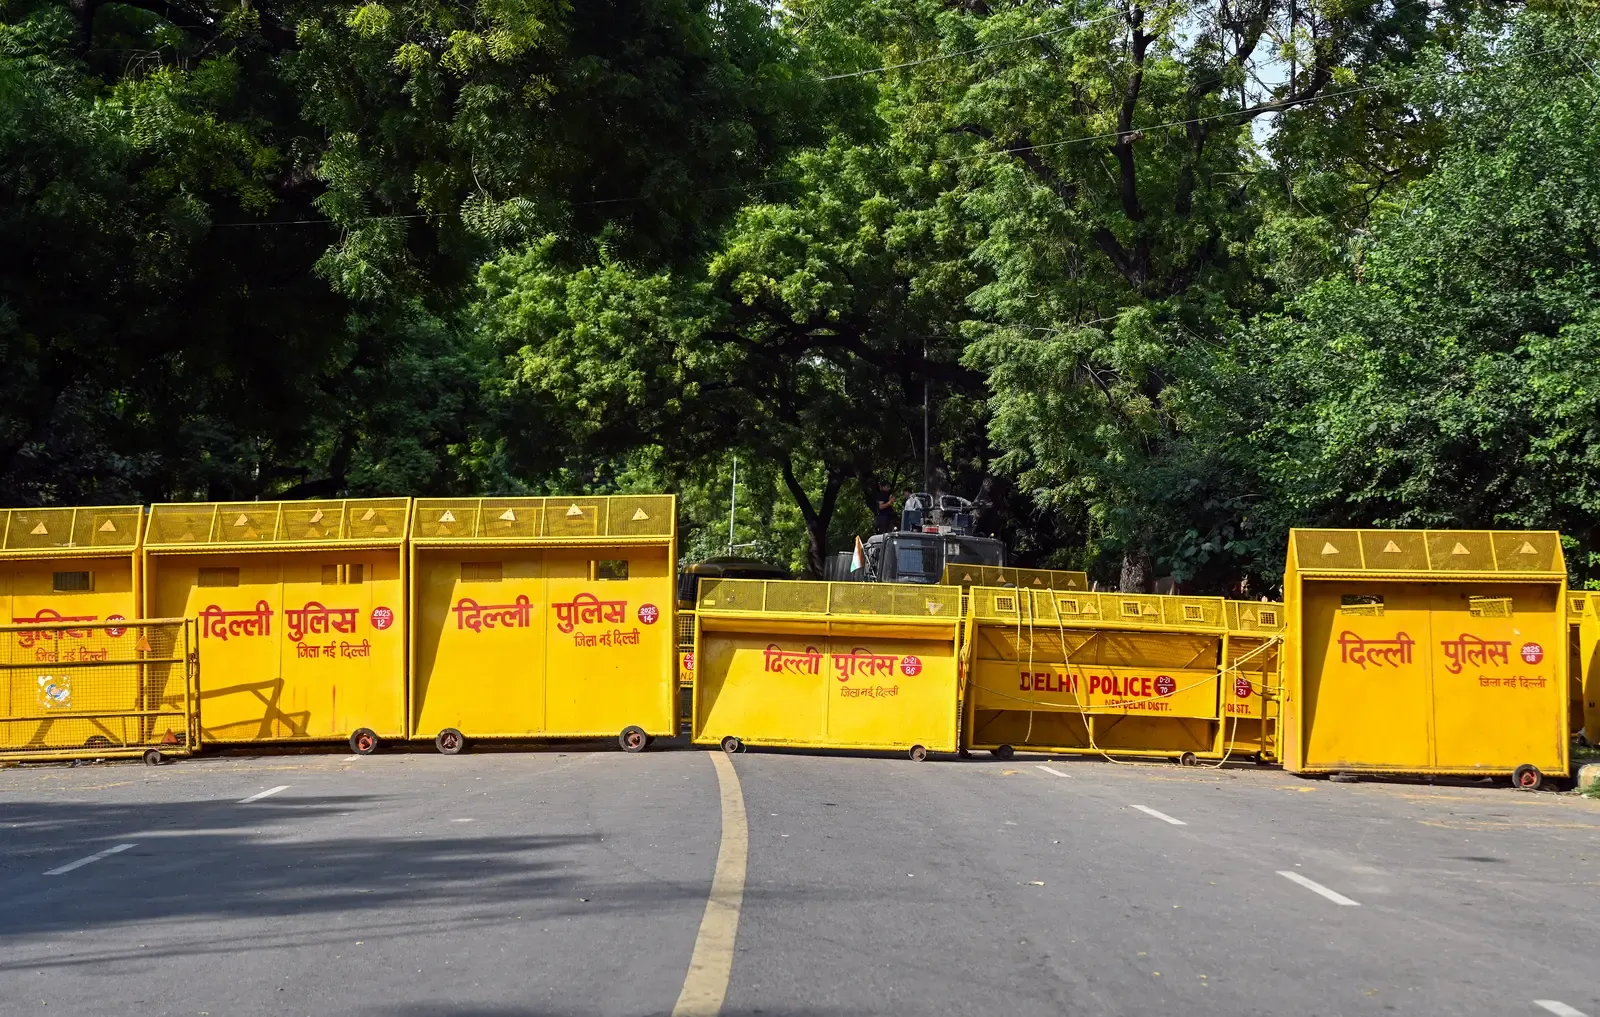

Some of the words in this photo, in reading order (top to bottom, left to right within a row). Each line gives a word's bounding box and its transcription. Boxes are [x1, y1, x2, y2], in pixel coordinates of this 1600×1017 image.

[373, 609, 390, 617] 2025
[452, 595, 533, 633] दिल्ली
[552, 593, 627, 633] पुलिस
[643, 615, 653, 623] 14
[199, 600, 274, 641] दिल्ली
[285, 601, 359, 642] पुलिस
[377, 619, 385, 629] 12
[574, 632, 597, 647] जिला
[599, 630, 612, 647] नई
[613, 628, 640, 645] दिल्ली
[296, 642, 320, 658] जिला
[323, 641, 336, 658] नई
[340, 639, 371, 659] दिल्ली
[1337, 630, 1416, 670] दिल्ली
[1441, 633, 1512, 674] पुलिस
[1522, 645, 1540, 653] 2025
[763, 644, 823, 675] दिल्ली
[832, 647, 898, 682] पुलिस
[1526, 654, 1536, 662] 08
[905, 666, 916, 675] 86
[1020, 672, 1078, 692] DELHI
[1089, 675, 1152, 697] POLICE
[1479, 675, 1501, 688] जिला
[1503, 676, 1517, 689] नई
[1519, 676, 1547, 690] दिल्ली
[840, 686, 860, 698] जिला
[861, 686, 875, 698] नई
[875, 685, 899, 698] दिल्ली
[1123, 700, 1146, 710] DELHI
[1148, 702, 1172, 712] DISTT.
